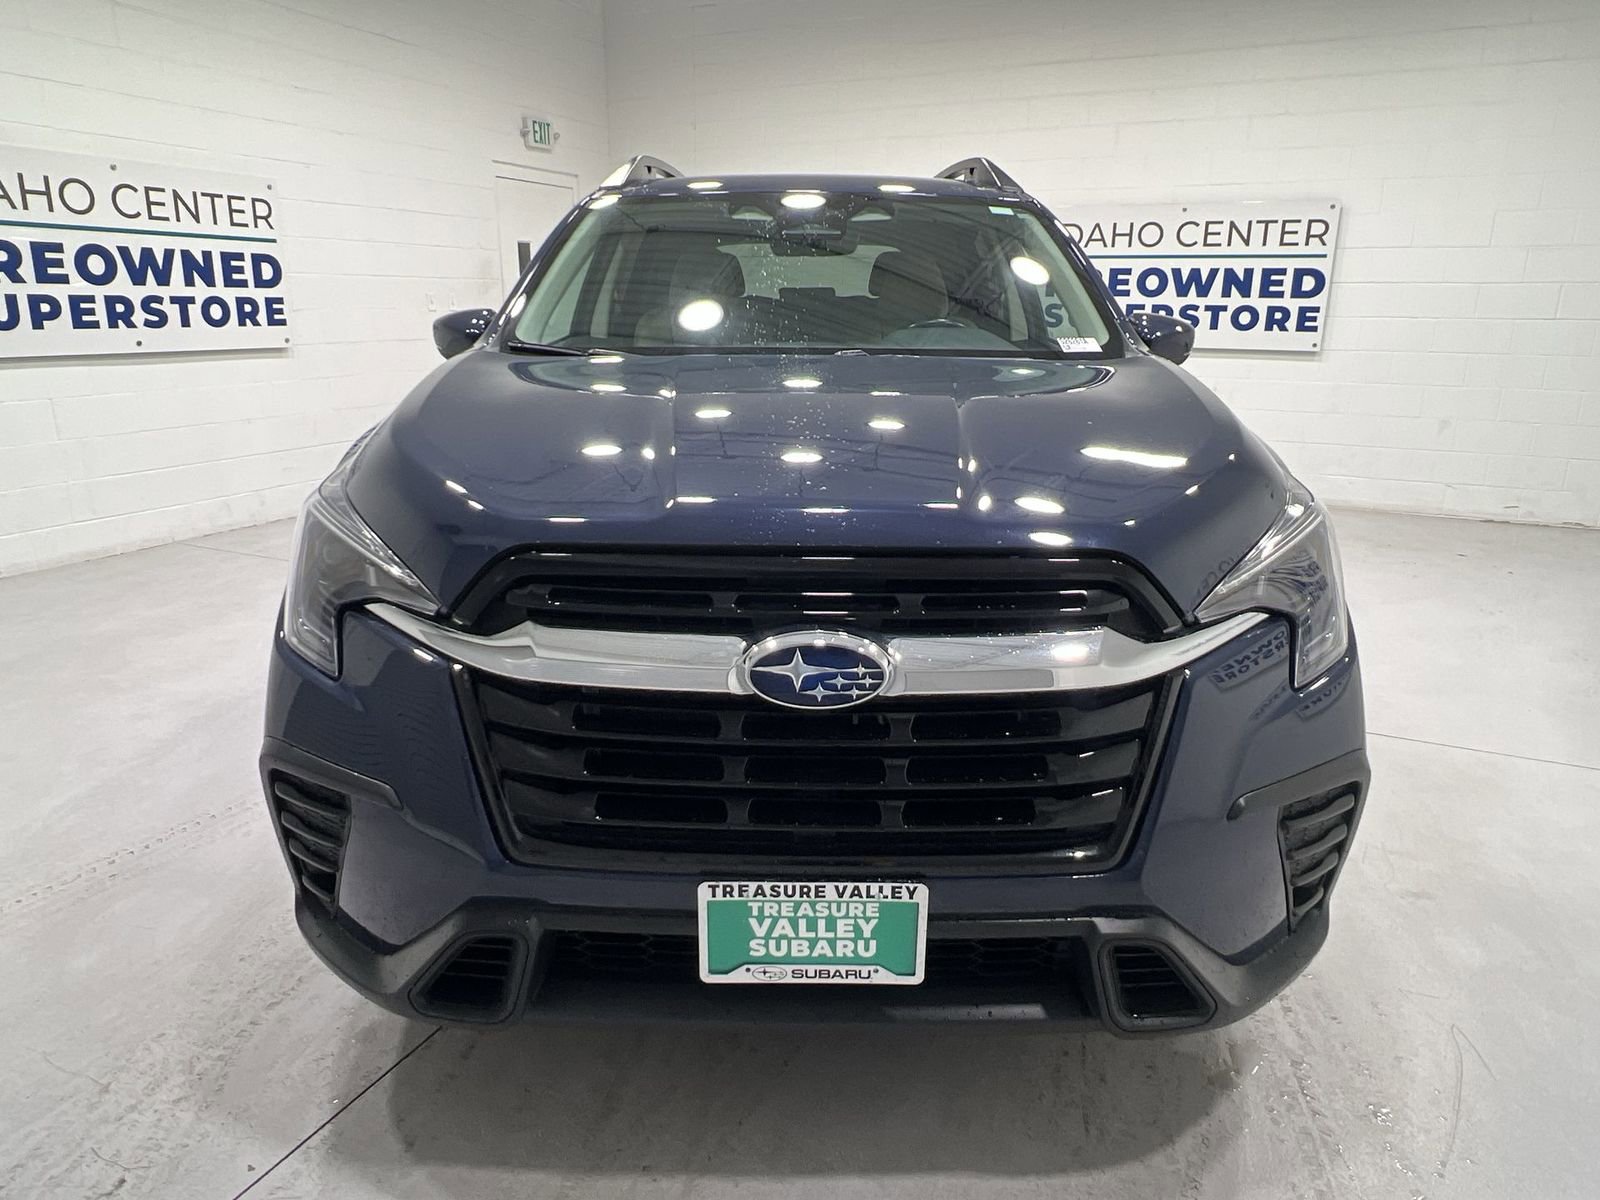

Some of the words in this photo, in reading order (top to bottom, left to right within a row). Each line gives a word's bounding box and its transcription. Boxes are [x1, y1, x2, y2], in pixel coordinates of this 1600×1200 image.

[532, 120, 551, 145] EXIT
[111, 183, 275, 230] CENTER
[1176, 218, 1330, 248] CENTER
[707, 884, 827, 899] TREASURE
[834, 885, 919, 900] VALLEY
[747, 901, 880, 917] TREASURE
[748, 918, 880, 938] VALLEY
[749, 939, 877, 958] SUBARU
[791, 969, 872, 980] SUBARU
